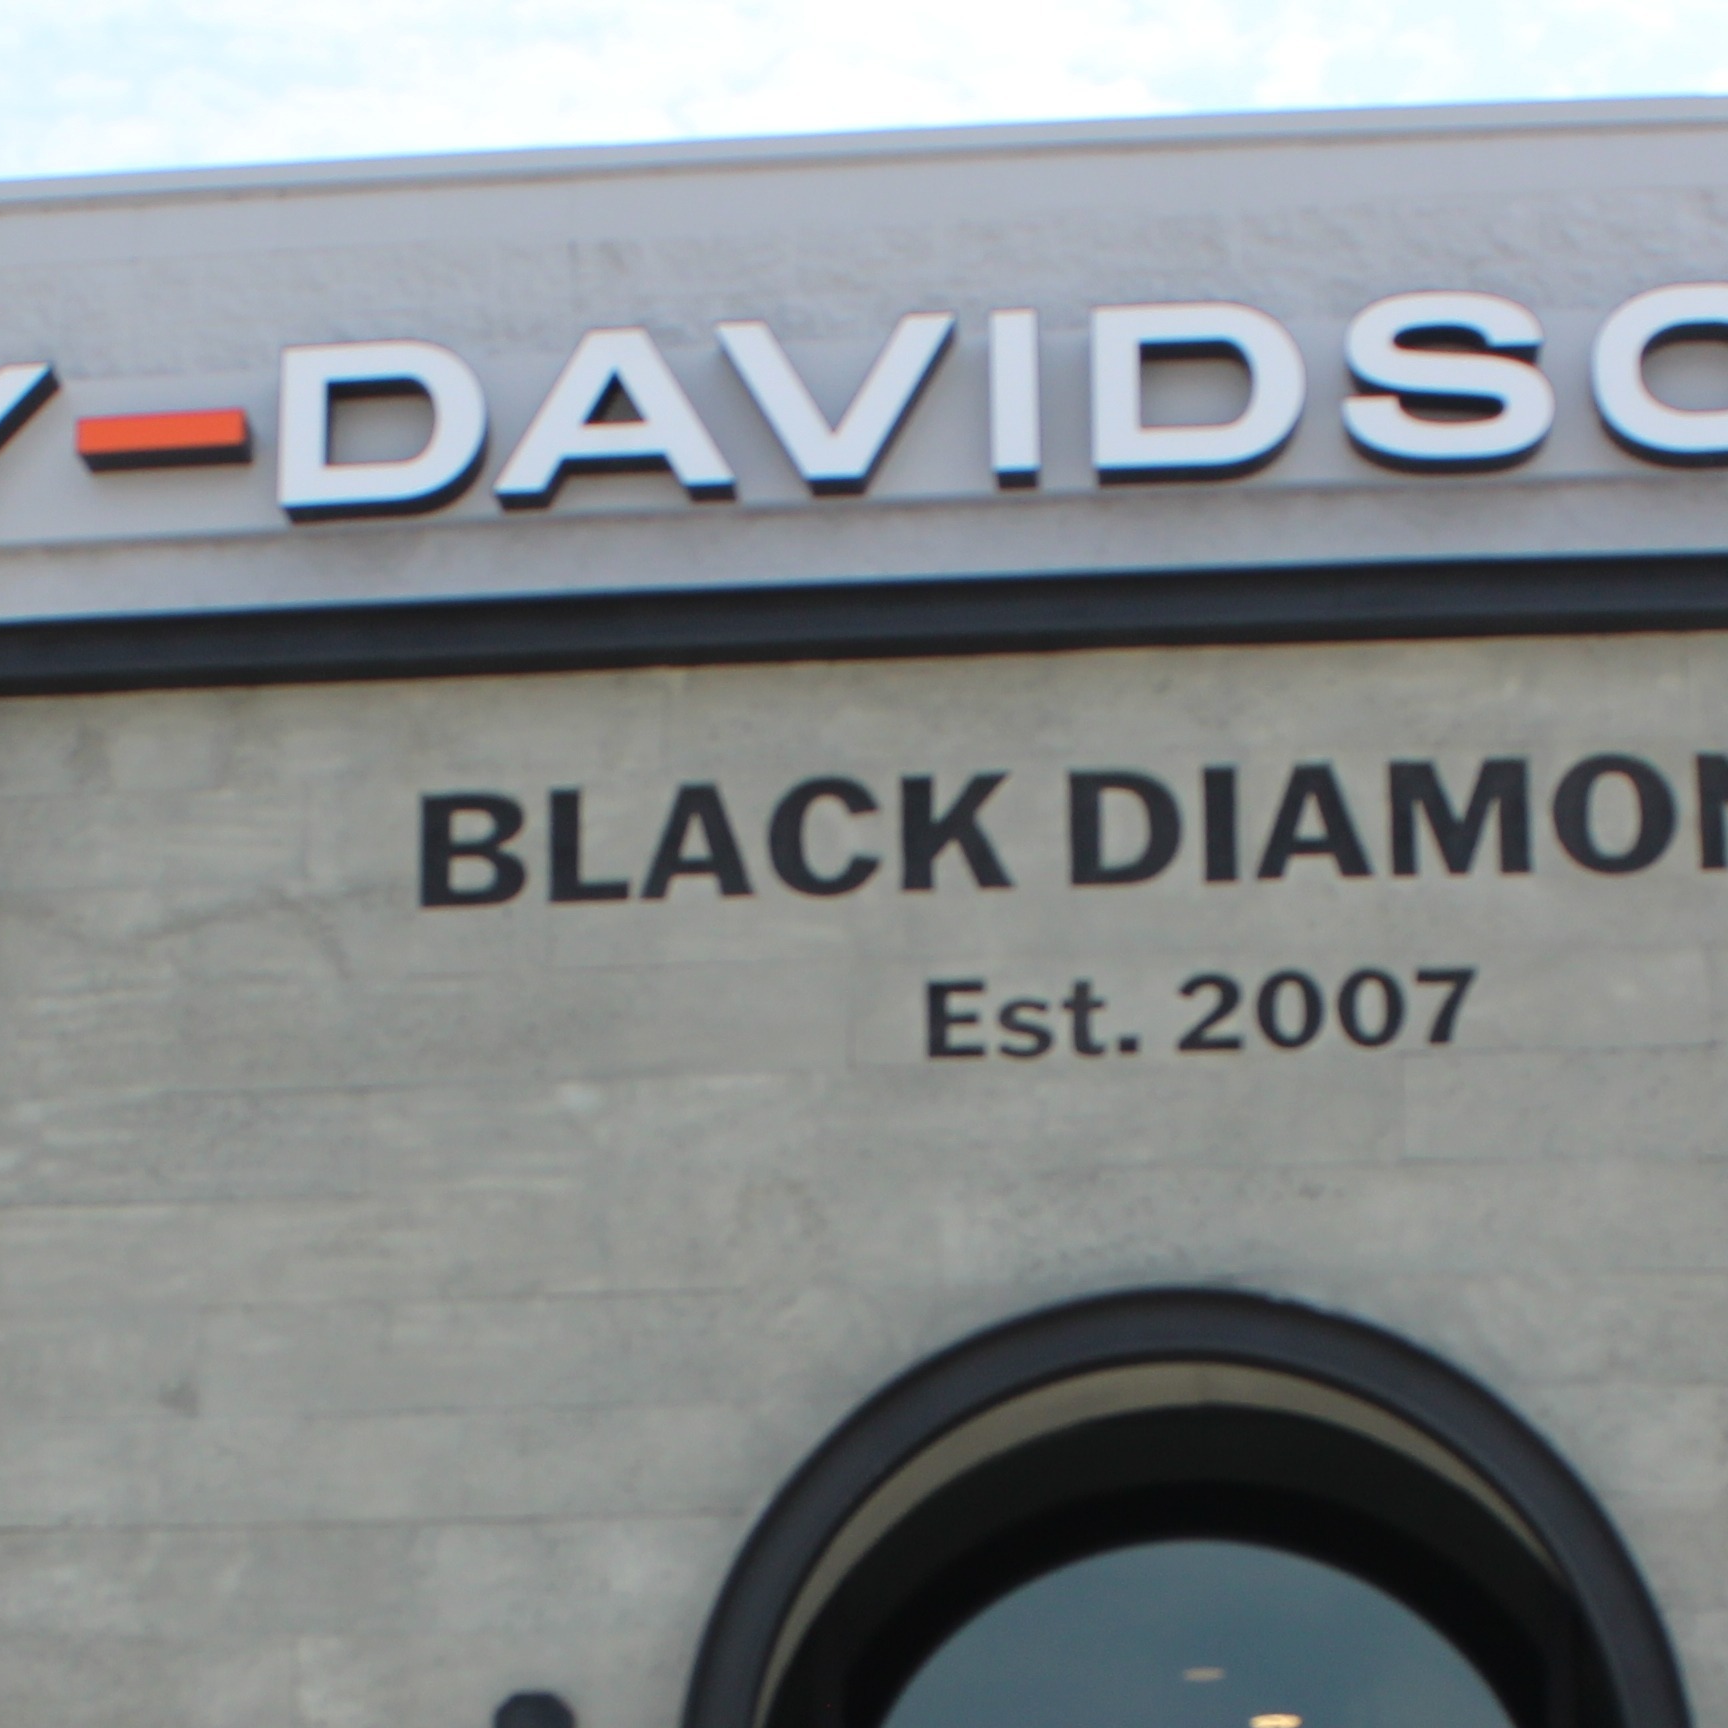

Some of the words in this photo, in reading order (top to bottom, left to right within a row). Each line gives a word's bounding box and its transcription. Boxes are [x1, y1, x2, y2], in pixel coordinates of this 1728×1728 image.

[419, 772, 1012, 908] BLACK
[925, 978, 1140, 1060] Est.
[1177, 968, 1478, 1053] 2007
